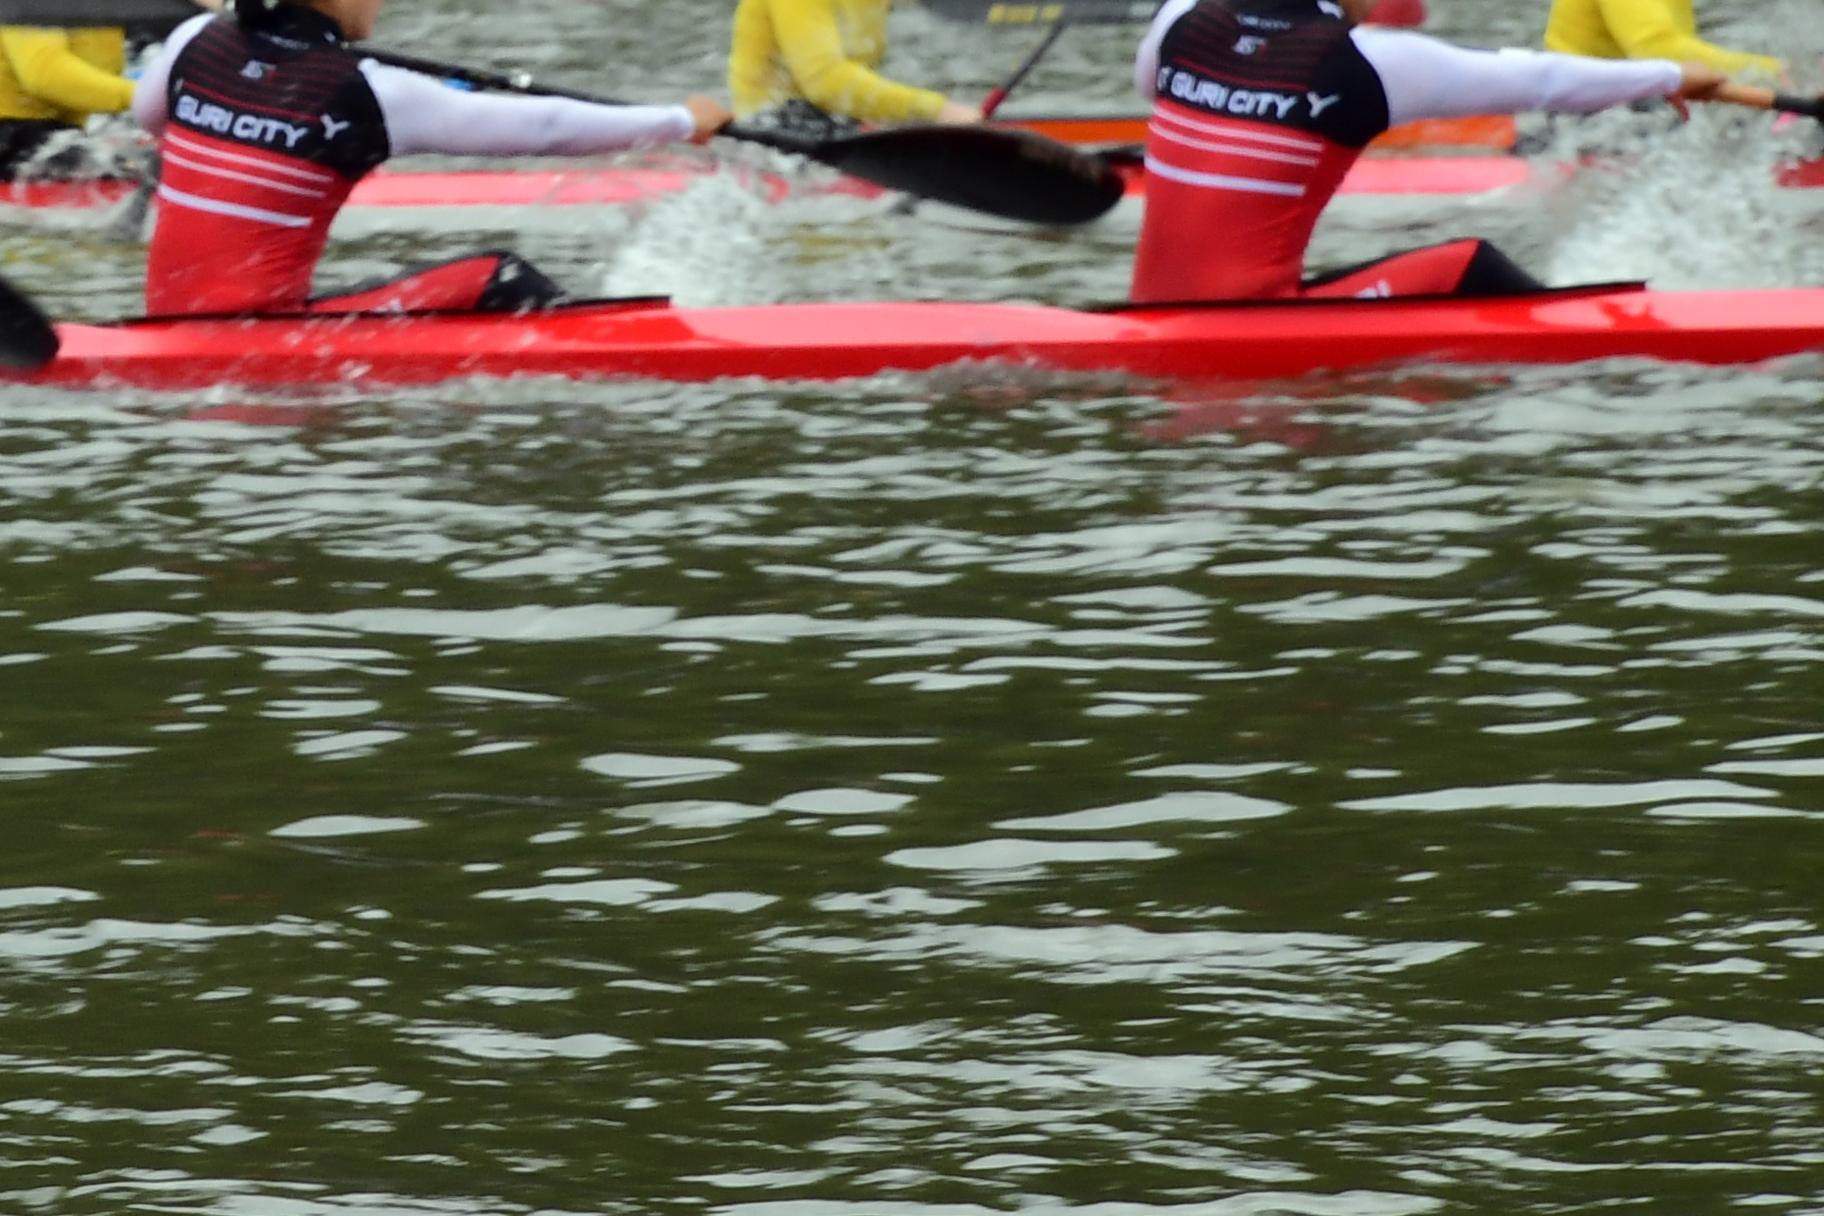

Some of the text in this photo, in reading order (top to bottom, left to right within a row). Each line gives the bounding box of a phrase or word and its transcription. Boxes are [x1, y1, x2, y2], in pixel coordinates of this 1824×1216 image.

[1170, 71, 1227, 109] GURI
[1228, 89, 1298, 119] CITY
[175, 94, 308, 148] GURI CITY
